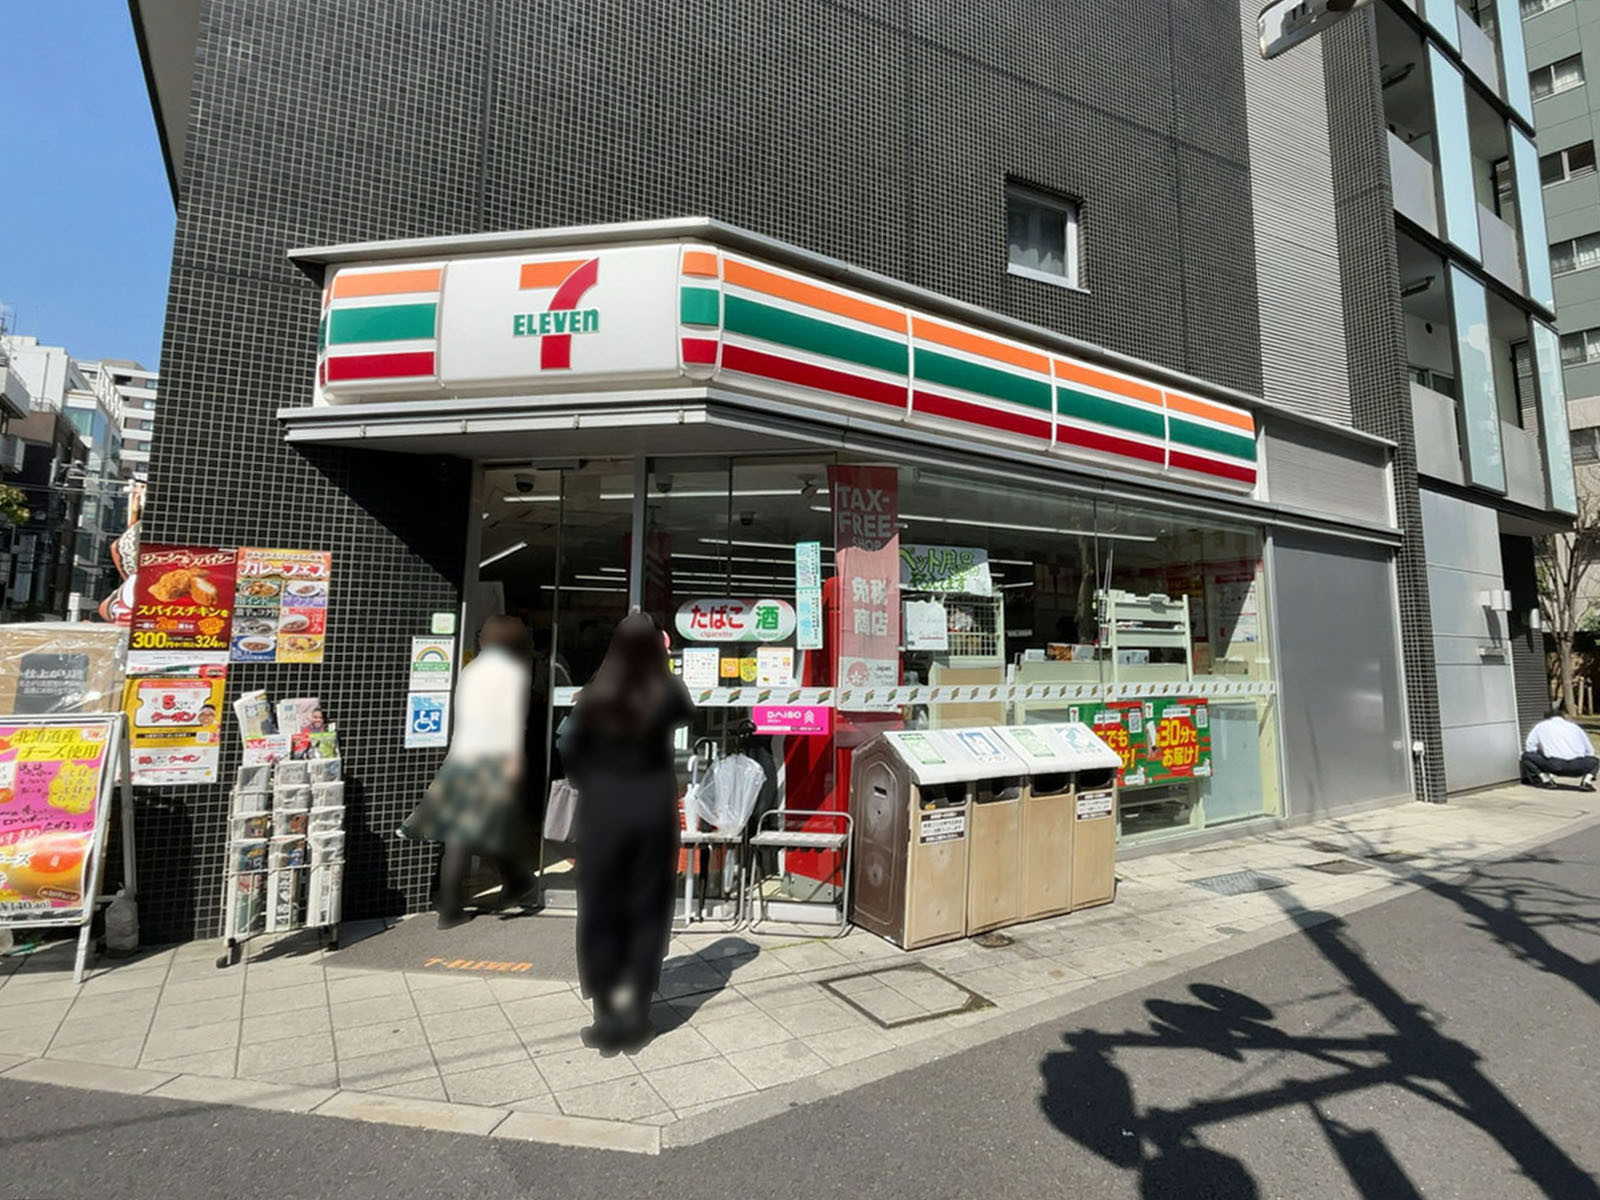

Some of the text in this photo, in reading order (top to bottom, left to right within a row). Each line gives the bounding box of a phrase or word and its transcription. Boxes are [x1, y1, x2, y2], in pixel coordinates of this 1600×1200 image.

[520, 258, 599, 370] 7
[838, 487, 891, 512] TAX-
[838, 511, 892, 537] FREE
[852, 537, 883, 552] SHOP
[240, 560, 327, 578] カレーフェス
[851, 576, 888, 605] 免税
[690, 604, 744, 630] たばこ
[755, 605, 779, 630] 酒
[853, 609, 888, 636] 商店
[15, 728, 77, 744] 北海道産
[22, 745, 98, 760] チーズ使用
